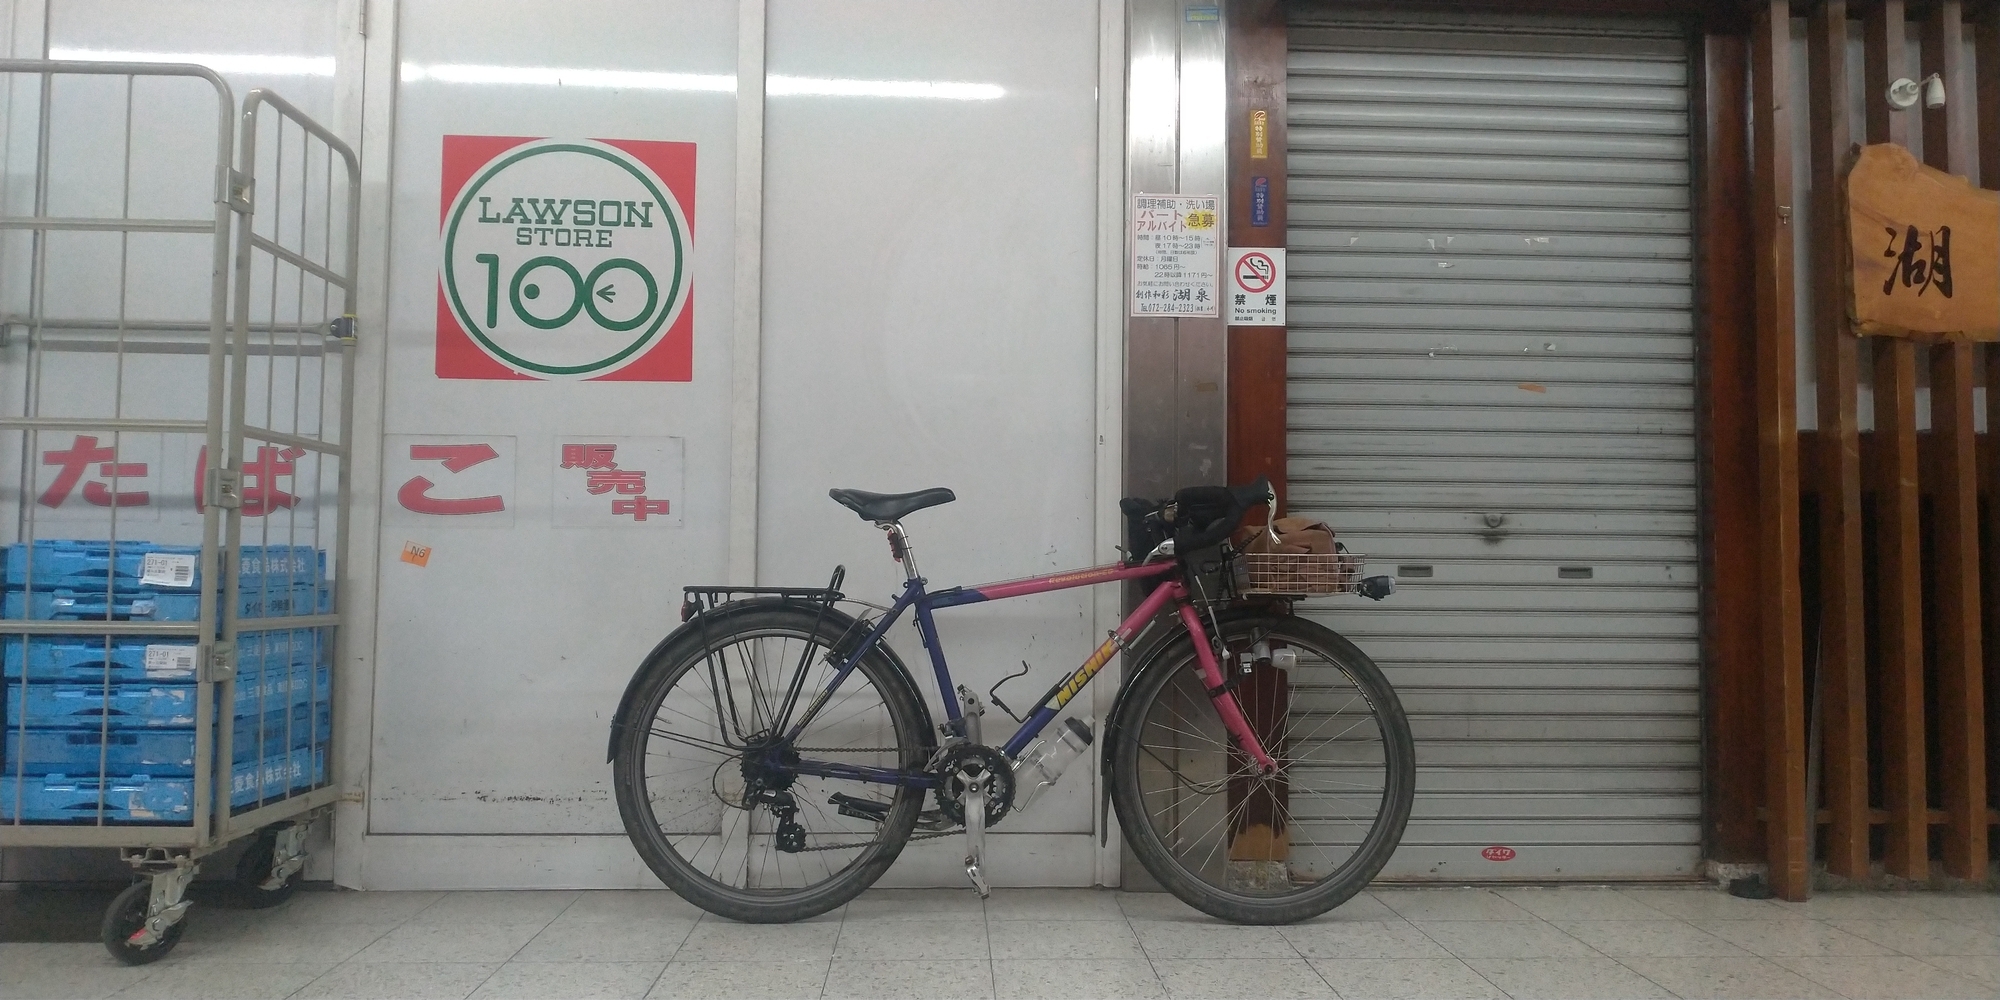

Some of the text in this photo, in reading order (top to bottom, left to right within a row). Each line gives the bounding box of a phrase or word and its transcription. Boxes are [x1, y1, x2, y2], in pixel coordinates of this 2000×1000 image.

[1137, 198, 1215, 210] 調理補助・洗い場
[478, 196, 653, 228] LAWSON
[1136, 220, 1187, 233] アルバイト
[1187, 213, 1215, 227] 急募
[515, 227, 613, 248] STORE
[1882, 224, 1953, 299] 湖
[475, 253, 659, 331] 100
[1172, 288, 1211, 302] 湖泉
[1234, 293, 1277, 306] 禁煙
[1246, 307, 1277, 315] smoking
[561, 443, 670, 522] 販売中
[146, 558, 168, 566] 271-01
[238, 556, 306, 575] 菱食品株式会社
[148, 650, 169, 658] 271-01
[1057, 638, 1117, 706] NISHIK
[230, 760, 302, 794] 菱食品株式会社
[1485, 848, 1511, 856] ダイワ
